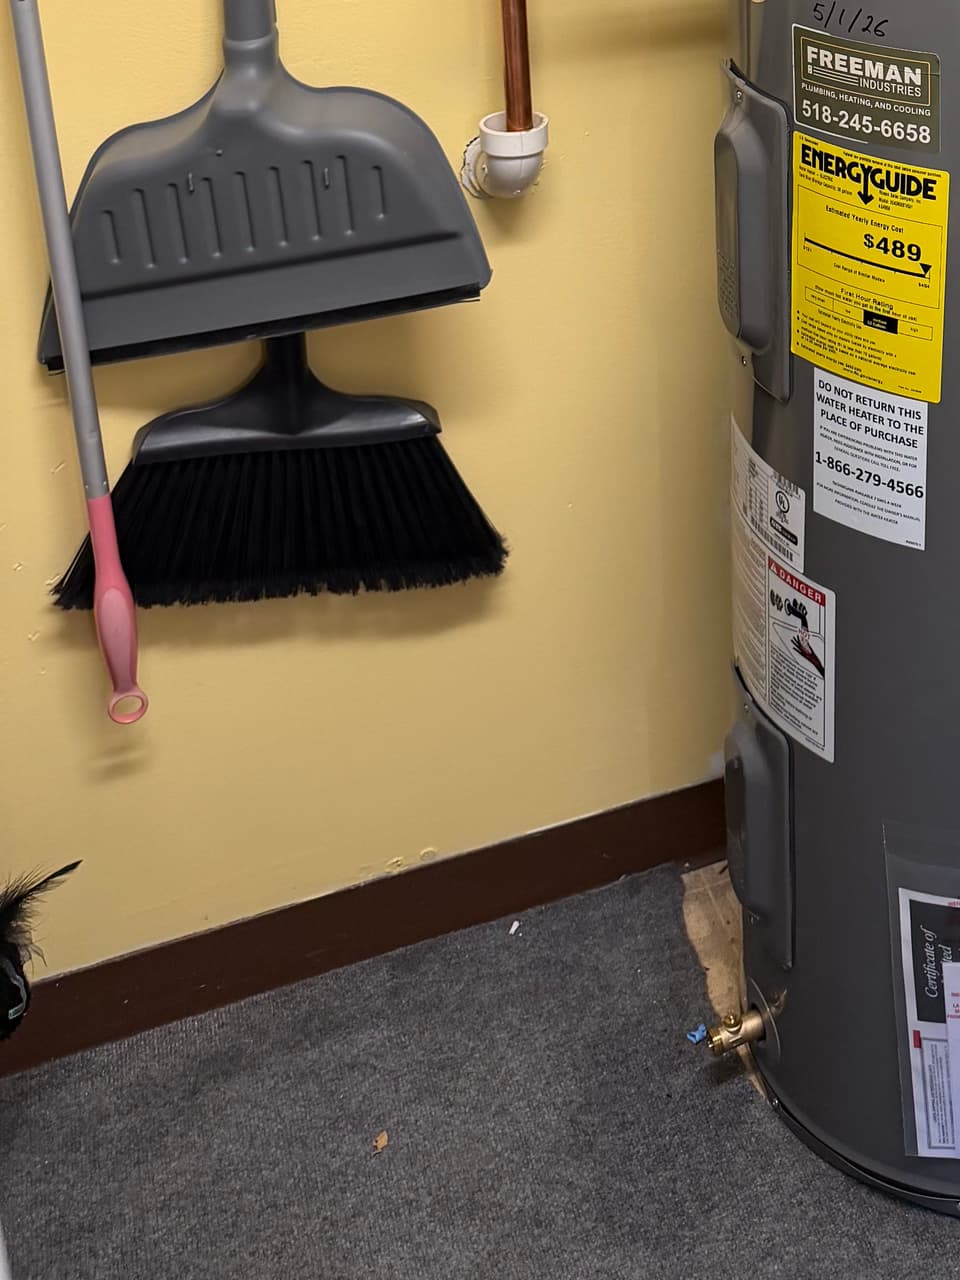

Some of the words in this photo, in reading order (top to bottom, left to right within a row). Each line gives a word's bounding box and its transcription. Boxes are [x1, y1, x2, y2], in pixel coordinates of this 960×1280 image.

[813, 1, 889, 37] 5/1/26
[806, 45, 922, 86] FREEMAN
[801, 82, 838, 100] PLUMBING,
[839, 93, 873, 109] HEATING,
[875, 101, 892, 111] AND
[893, 104, 931, 117] COOLING
[860, 78, 922, 97] INDUSTRIES
[801, 99, 931, 144] 518-245-6658
[801, 143, 937, 205] ENERGYGUIDE
[825, 204, 851, 219] Estimated
[852, 214, 869, 226] Yearly
[870, 220, 890, 232] Energy
[891, 225, 904, 234] Cost
[863, 233, 921, 262] $489
[840, 288, 855, 298] First
[855, 293, 871, 303] Hour
[872, 298, 894, 310] Rating
[816, 391, 847, 413] WATER
[848, 405, 885, 426] HEATER
[887, 417, 901, 430] TO
[903, 422, 924, 435] THE
[818, 379, 832, 392] DO
[833, 386, 854, 401] NOT
[855, 394, 896, 414] RETURN
[897, 406, 922, 420] THIS
[820, 408, 847, 427] PLACE
[849, 420, 862, 432] OF
[864, 425, 918, 449] PURCHASE
[815, 451, 924, 498] 1-866-279-4566
[779, 570, 822, 604] DANGER
[920, 925, 937, 941] of
[924, 942, 941, 998] Certificate
